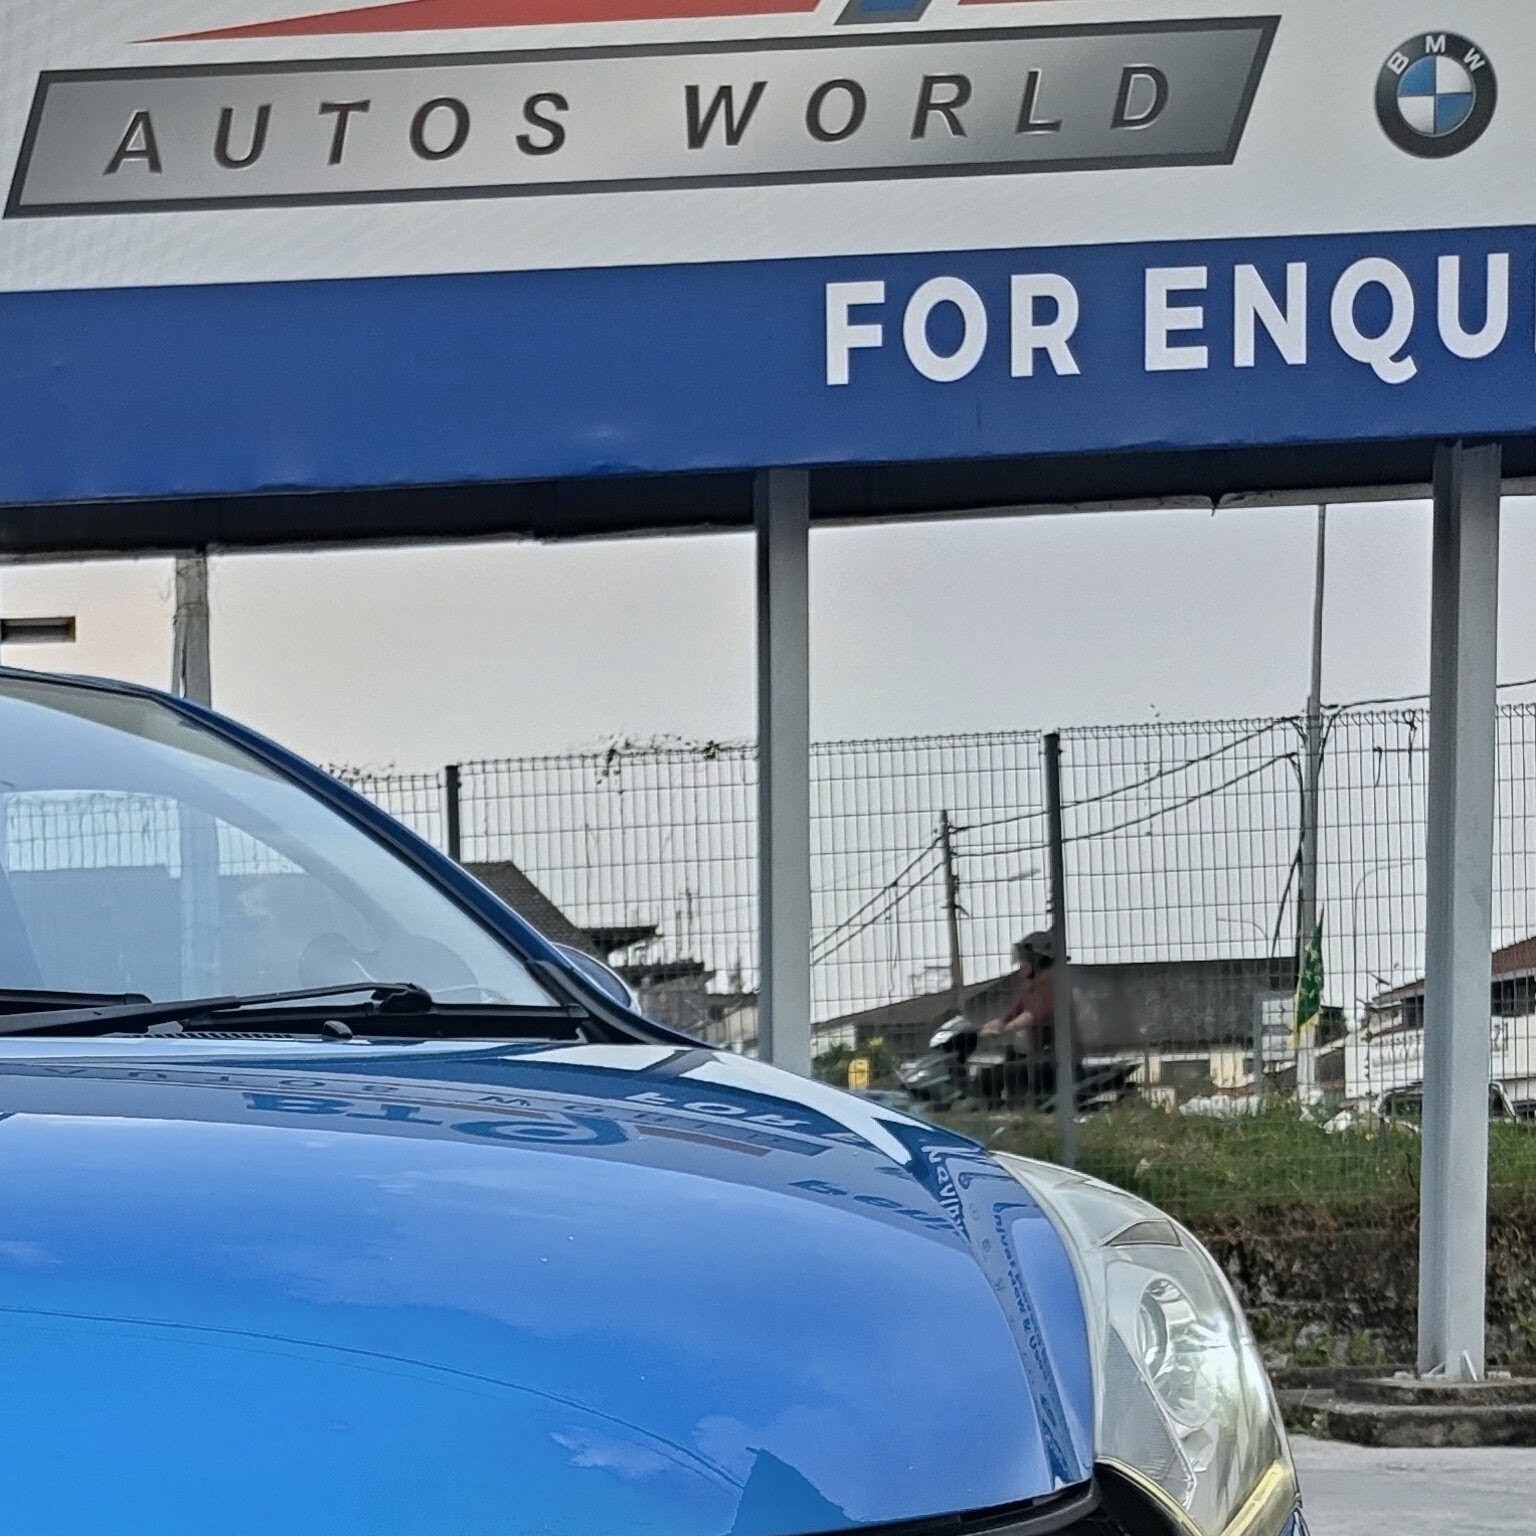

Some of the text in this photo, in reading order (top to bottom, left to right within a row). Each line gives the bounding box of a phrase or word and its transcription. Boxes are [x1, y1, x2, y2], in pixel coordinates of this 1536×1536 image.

[1386, 34, 1486, 76] BMW
[103, 64, 1171, 176] AUTOS WORLD
[825, 252, 1536, 386] FOR ENQU
